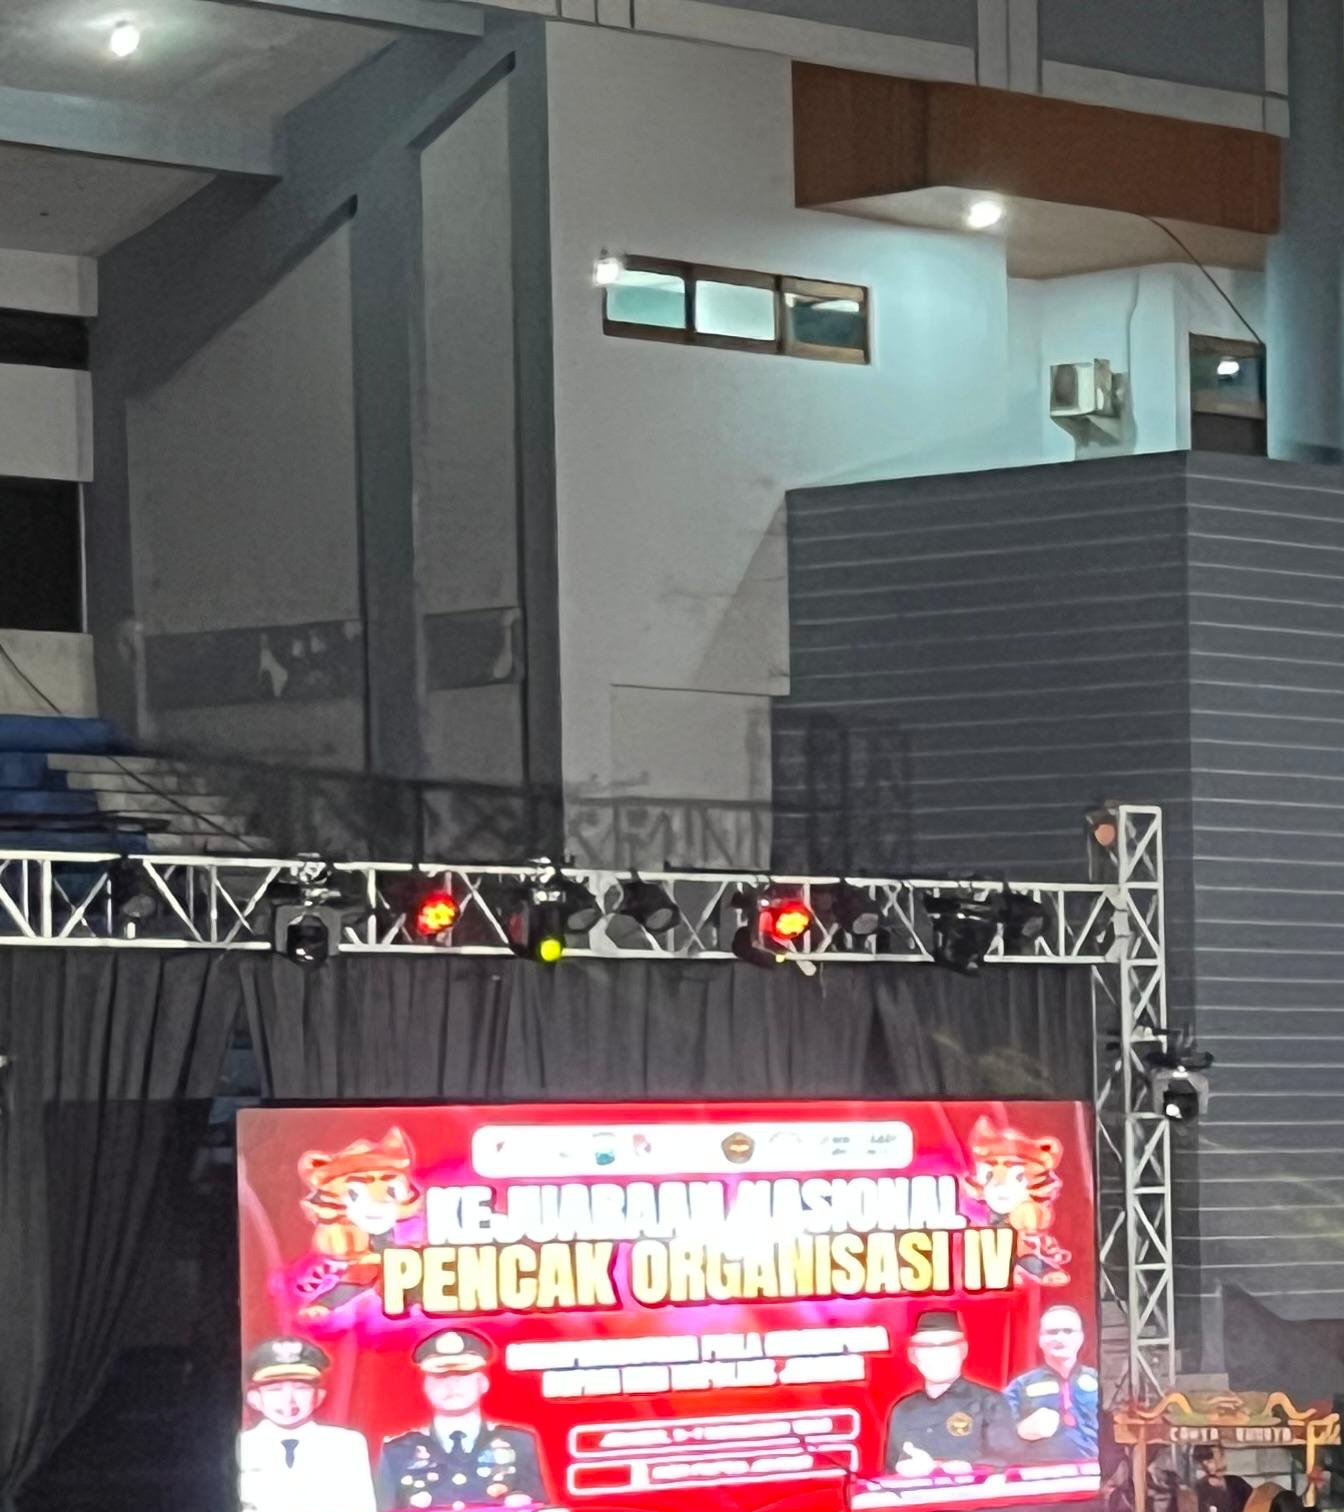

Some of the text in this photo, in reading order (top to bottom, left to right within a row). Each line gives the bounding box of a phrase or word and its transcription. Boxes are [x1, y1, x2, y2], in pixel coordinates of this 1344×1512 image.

[426, 1175, 967, 1245] KEJUARAAN NASIONAL
[382, 1227, 1014, 1314] PENCAK ORGANISASI IV
